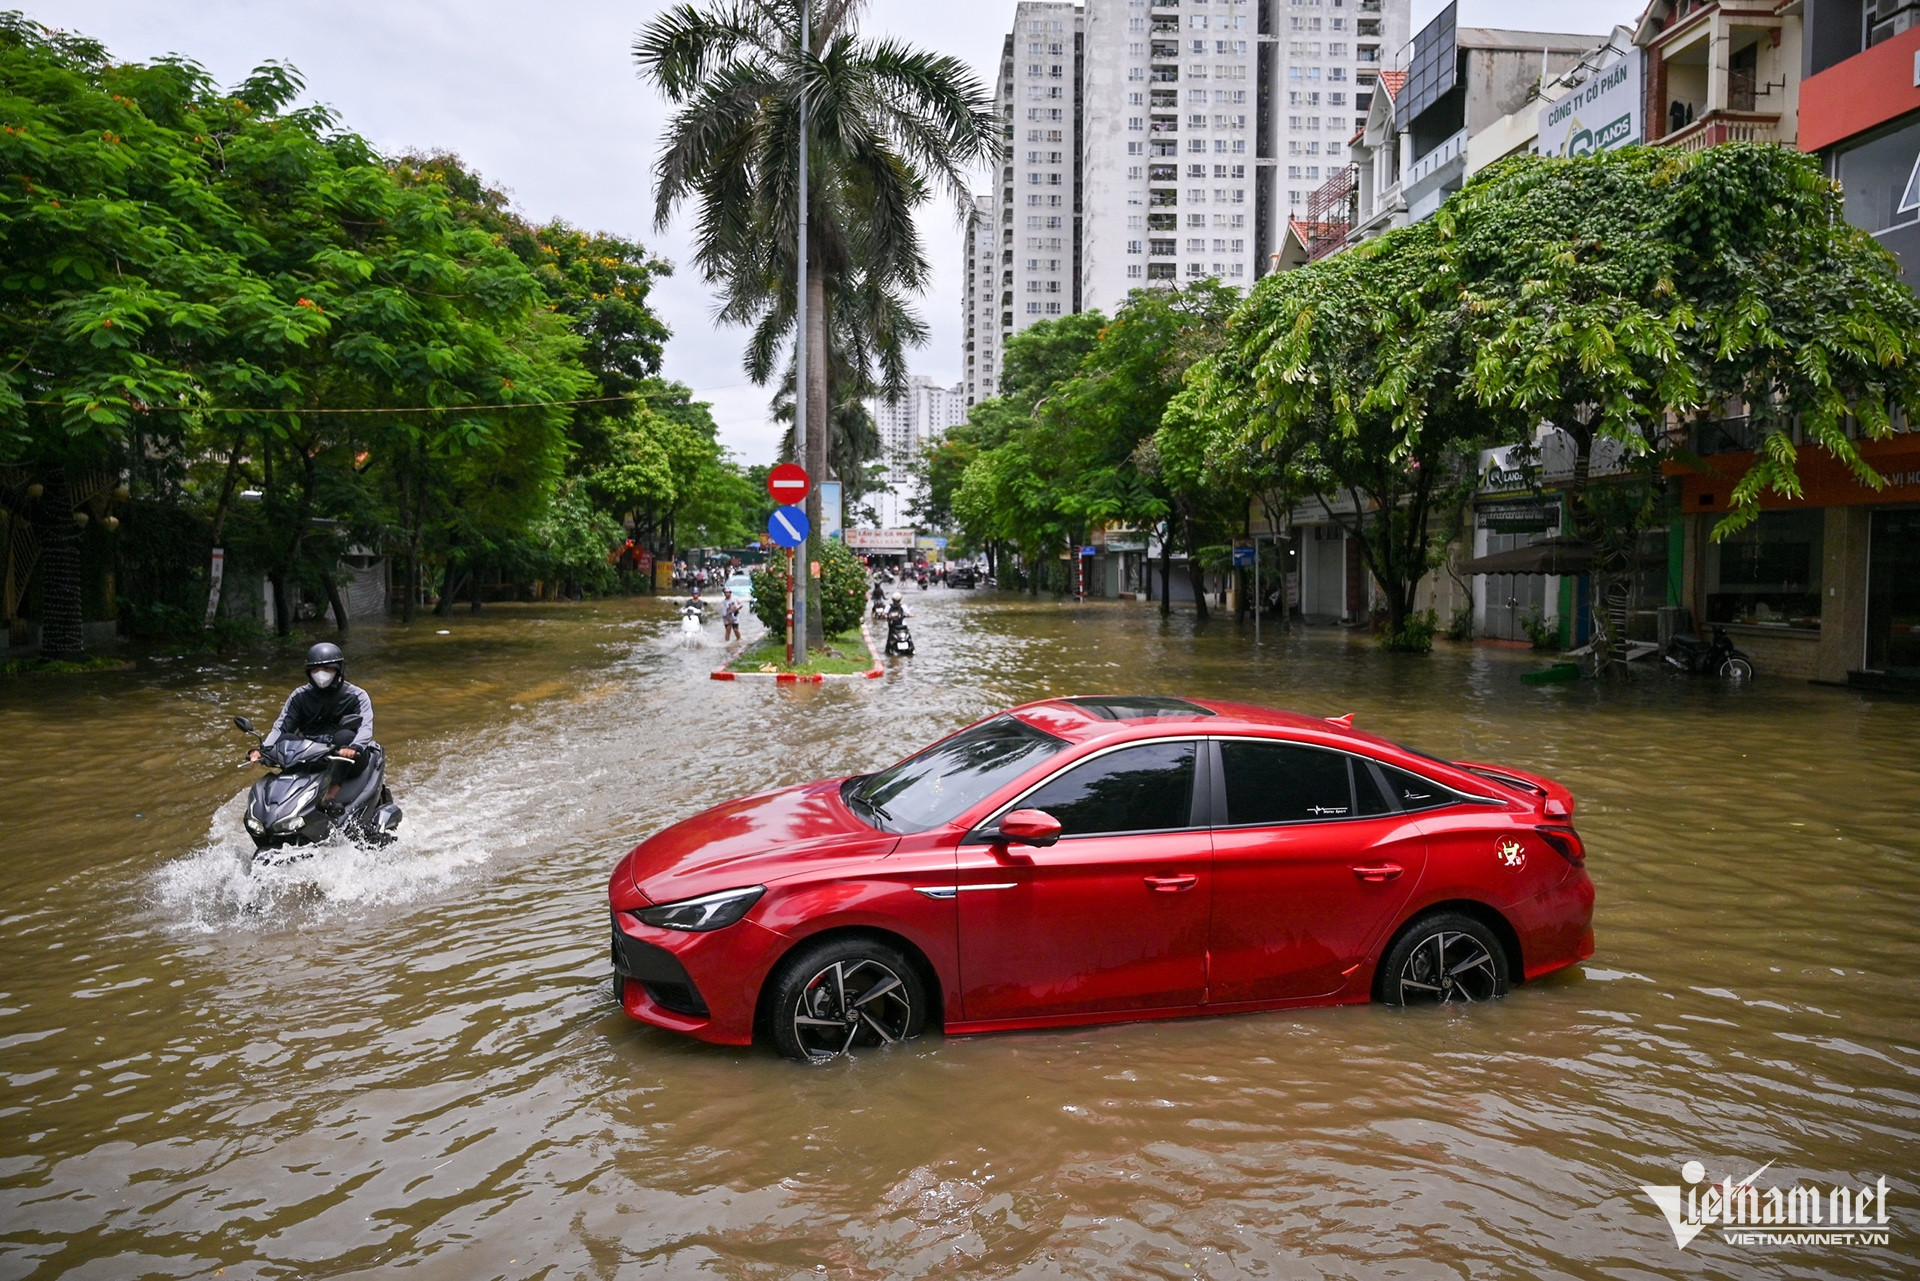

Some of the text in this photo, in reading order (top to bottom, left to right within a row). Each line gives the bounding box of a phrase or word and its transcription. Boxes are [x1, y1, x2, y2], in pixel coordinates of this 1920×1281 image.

[1548, 65, 1628, 127] CÔNG TY CỔ PHẦN
[1596, 118, 1629, 145] LANDS
